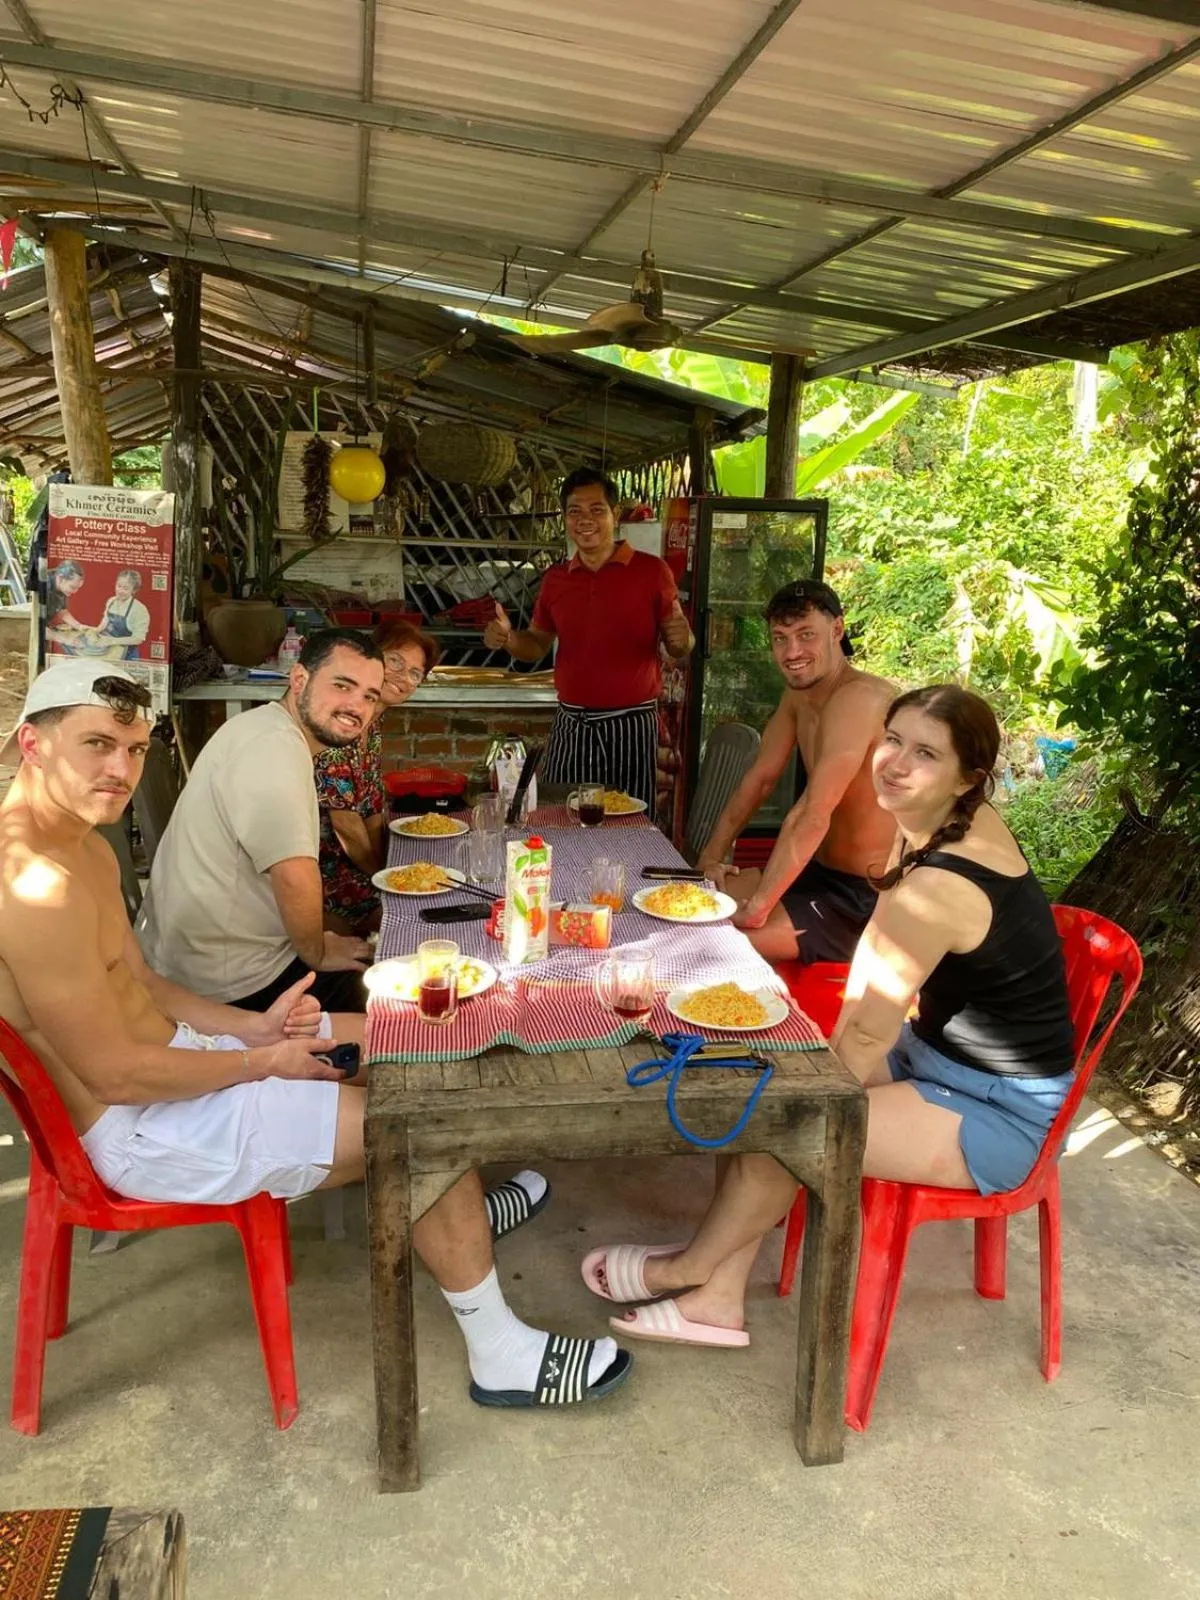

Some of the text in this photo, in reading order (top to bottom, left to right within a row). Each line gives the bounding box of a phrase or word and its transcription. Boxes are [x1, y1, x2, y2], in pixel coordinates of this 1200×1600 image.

[66, 499, 157, 515] Khmer Ceramics
[75, 518, 147, 534] Pottery Class
[65, 529, 157, 543] Local Community Experience
[66, 537, 89, 546] Gallery
[94, 539, 108, 547] Free
[110, 541, 143, 551] Workshop
